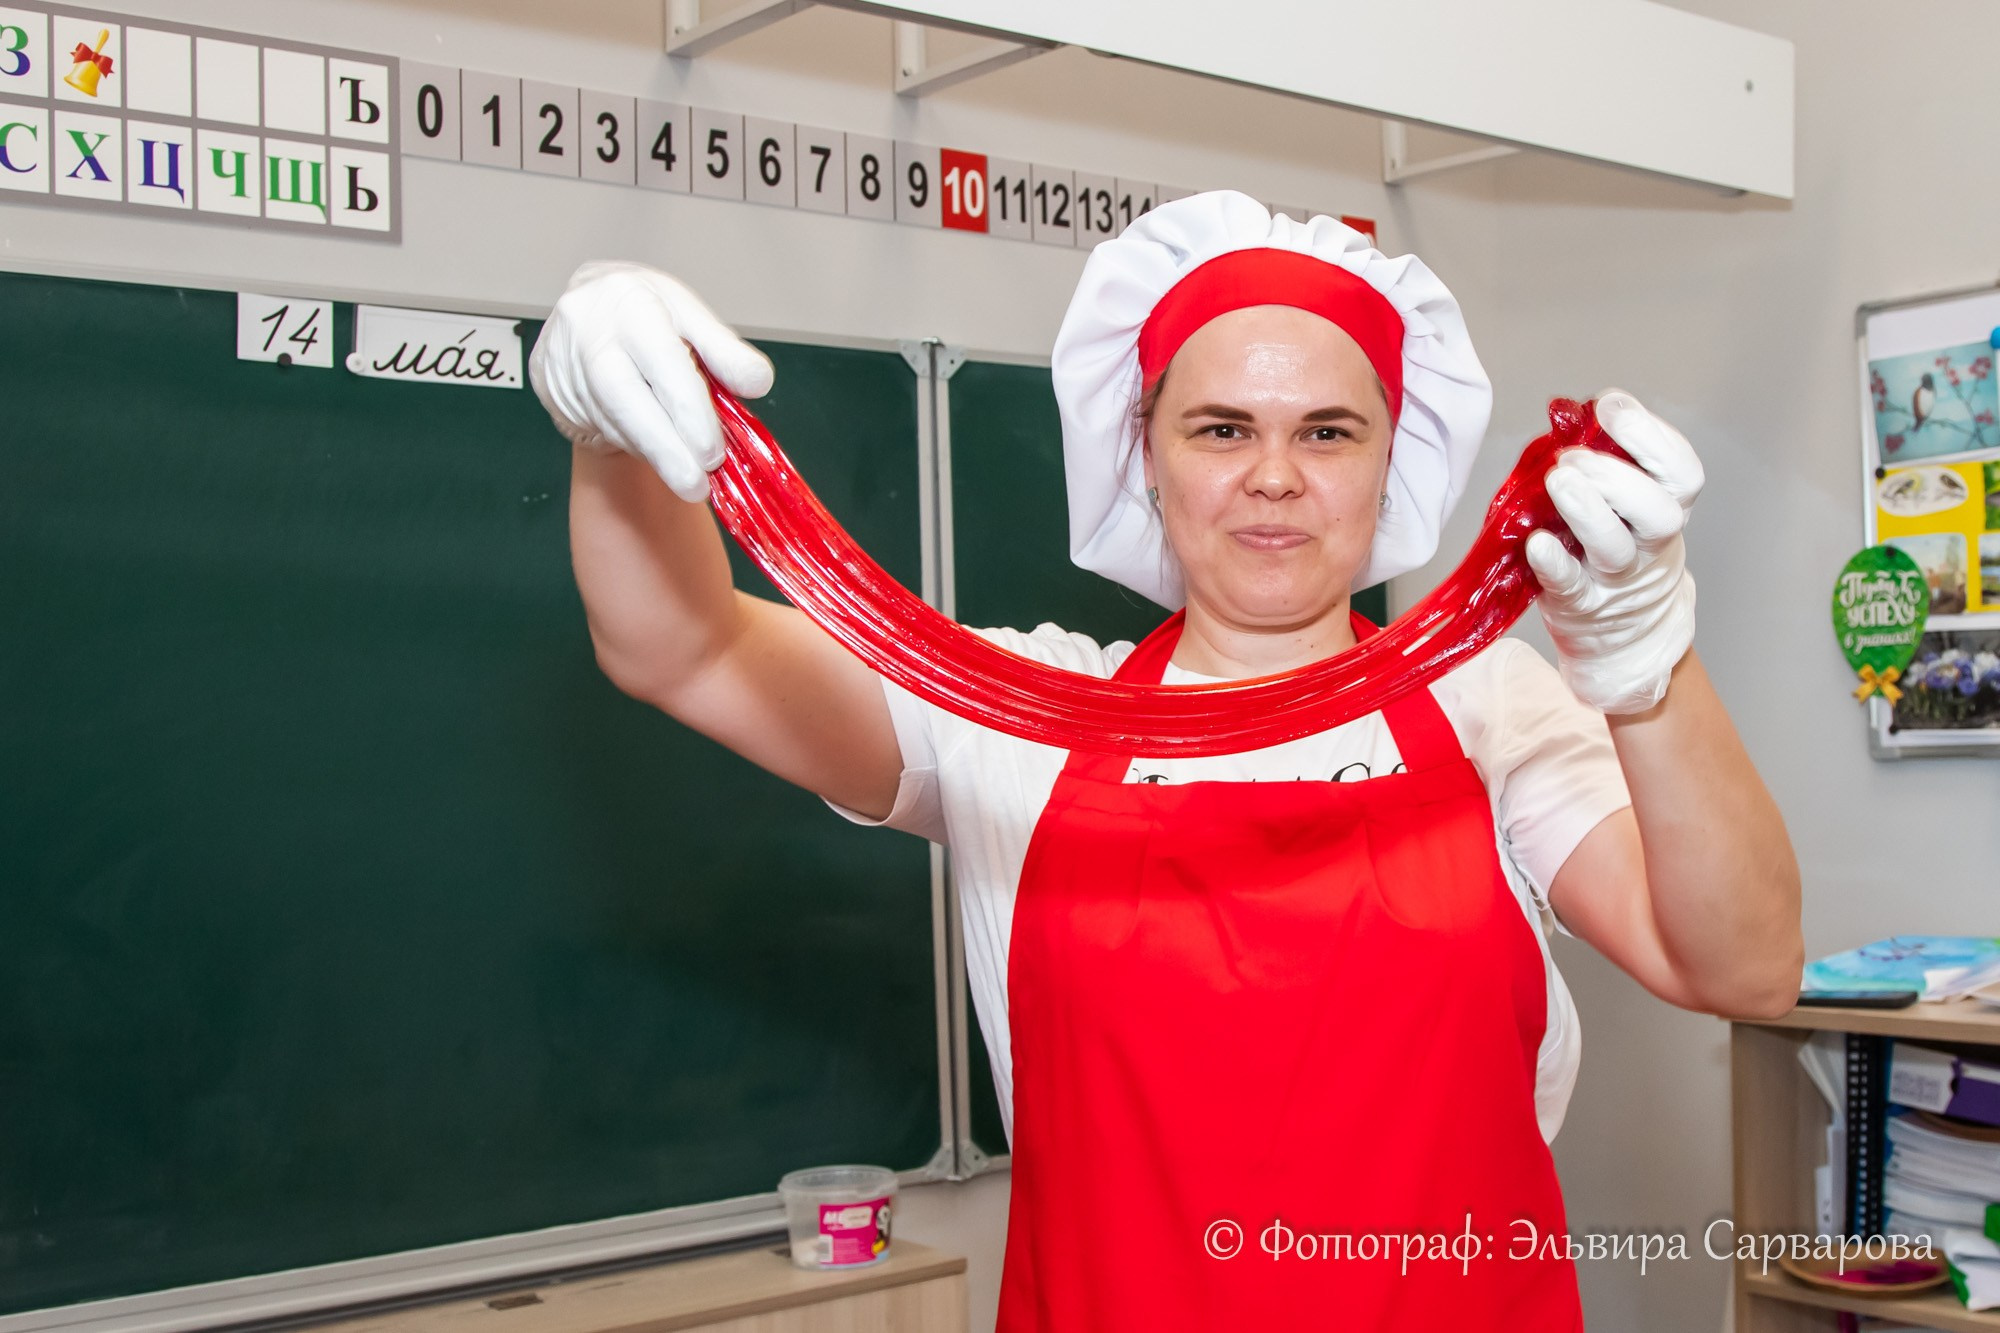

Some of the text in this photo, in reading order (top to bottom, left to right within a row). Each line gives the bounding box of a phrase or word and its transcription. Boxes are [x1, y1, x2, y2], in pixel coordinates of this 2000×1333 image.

[0, 24, 380, 124] З Ъ
[0, 122, 378, 219] С Х Ц Ч Щ Ь
[417, 84, 443, 138] 0
[482, 94, 501, 147] 1
[538, 103, 564, 156] 2
[596, 111, 620, 164] 3
[650, 121, 677, 172] 4
[706, 128, 730, 179] 5
[759, 137, 782, 187] 6
[810, 145, 832, 193] 7
[860, 153, 881, 202] 8
[907, 161, 929, 209] 9
[944, 166, 985, 218] 10
[993, 176, 1027, 224] 11
[1034, 180, 1071, 228] 12
[1077, 187, 1114, 234] 13
[261, 305, 320, 355] 14
